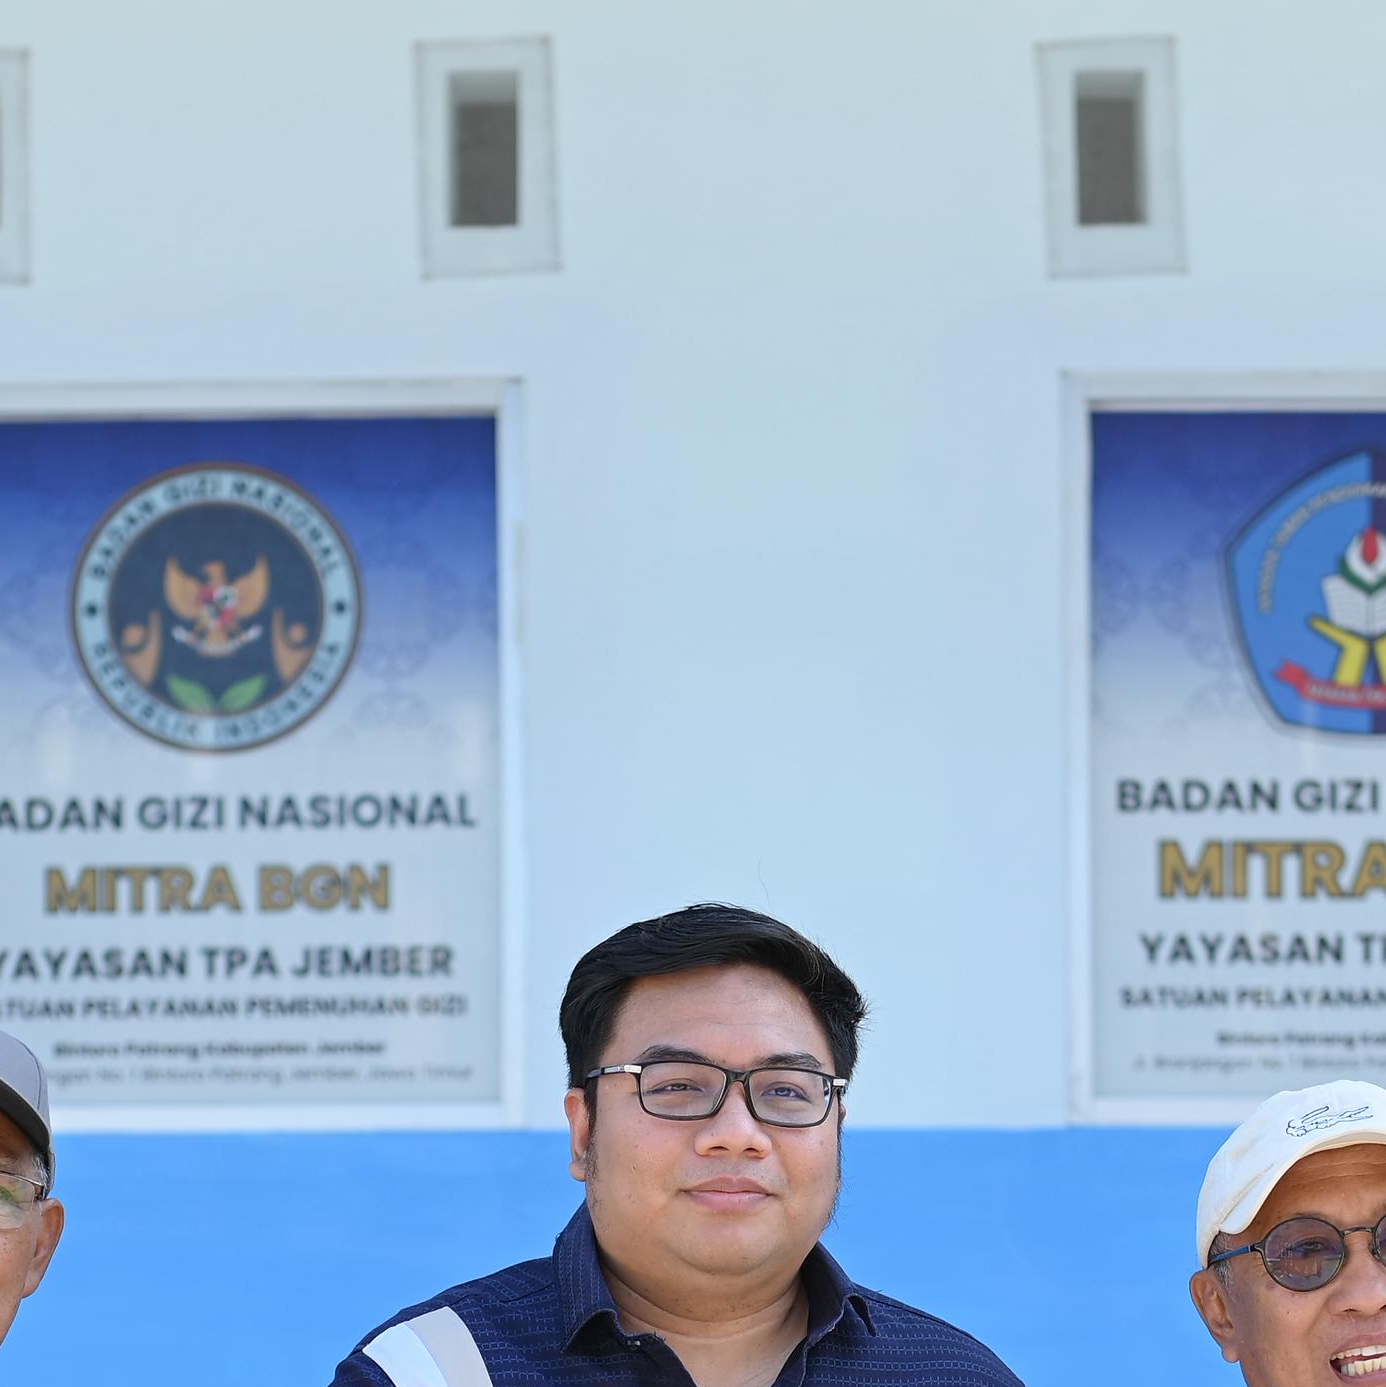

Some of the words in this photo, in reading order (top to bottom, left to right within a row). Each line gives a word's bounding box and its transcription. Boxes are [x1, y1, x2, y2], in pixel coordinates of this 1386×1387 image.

[93, 501, 155, 578] BADAN
[233, 481, 340, 573] NASIONAL
[137, 796, 225, 830] GIZI
[238, 794, 476, 829] NASIONAL
[1117, 780, 1280, 814] BADAN
[1293, 780, 1380, 813] GIZI
[44, 865, 242, 914] MITRA
[257, 863, 393, 912] BGN
[199, 948, 279, 978] TPA
[292, 946, 454, 977] JEMBER
[1141, 933, 1345, 966] YAYASAN
[82, 998, 240, 1019] PELAYANAN
[247, 996, 409, 1017] PEMENUHAN
[1120, 986, 1227, 1008] SATUAN
